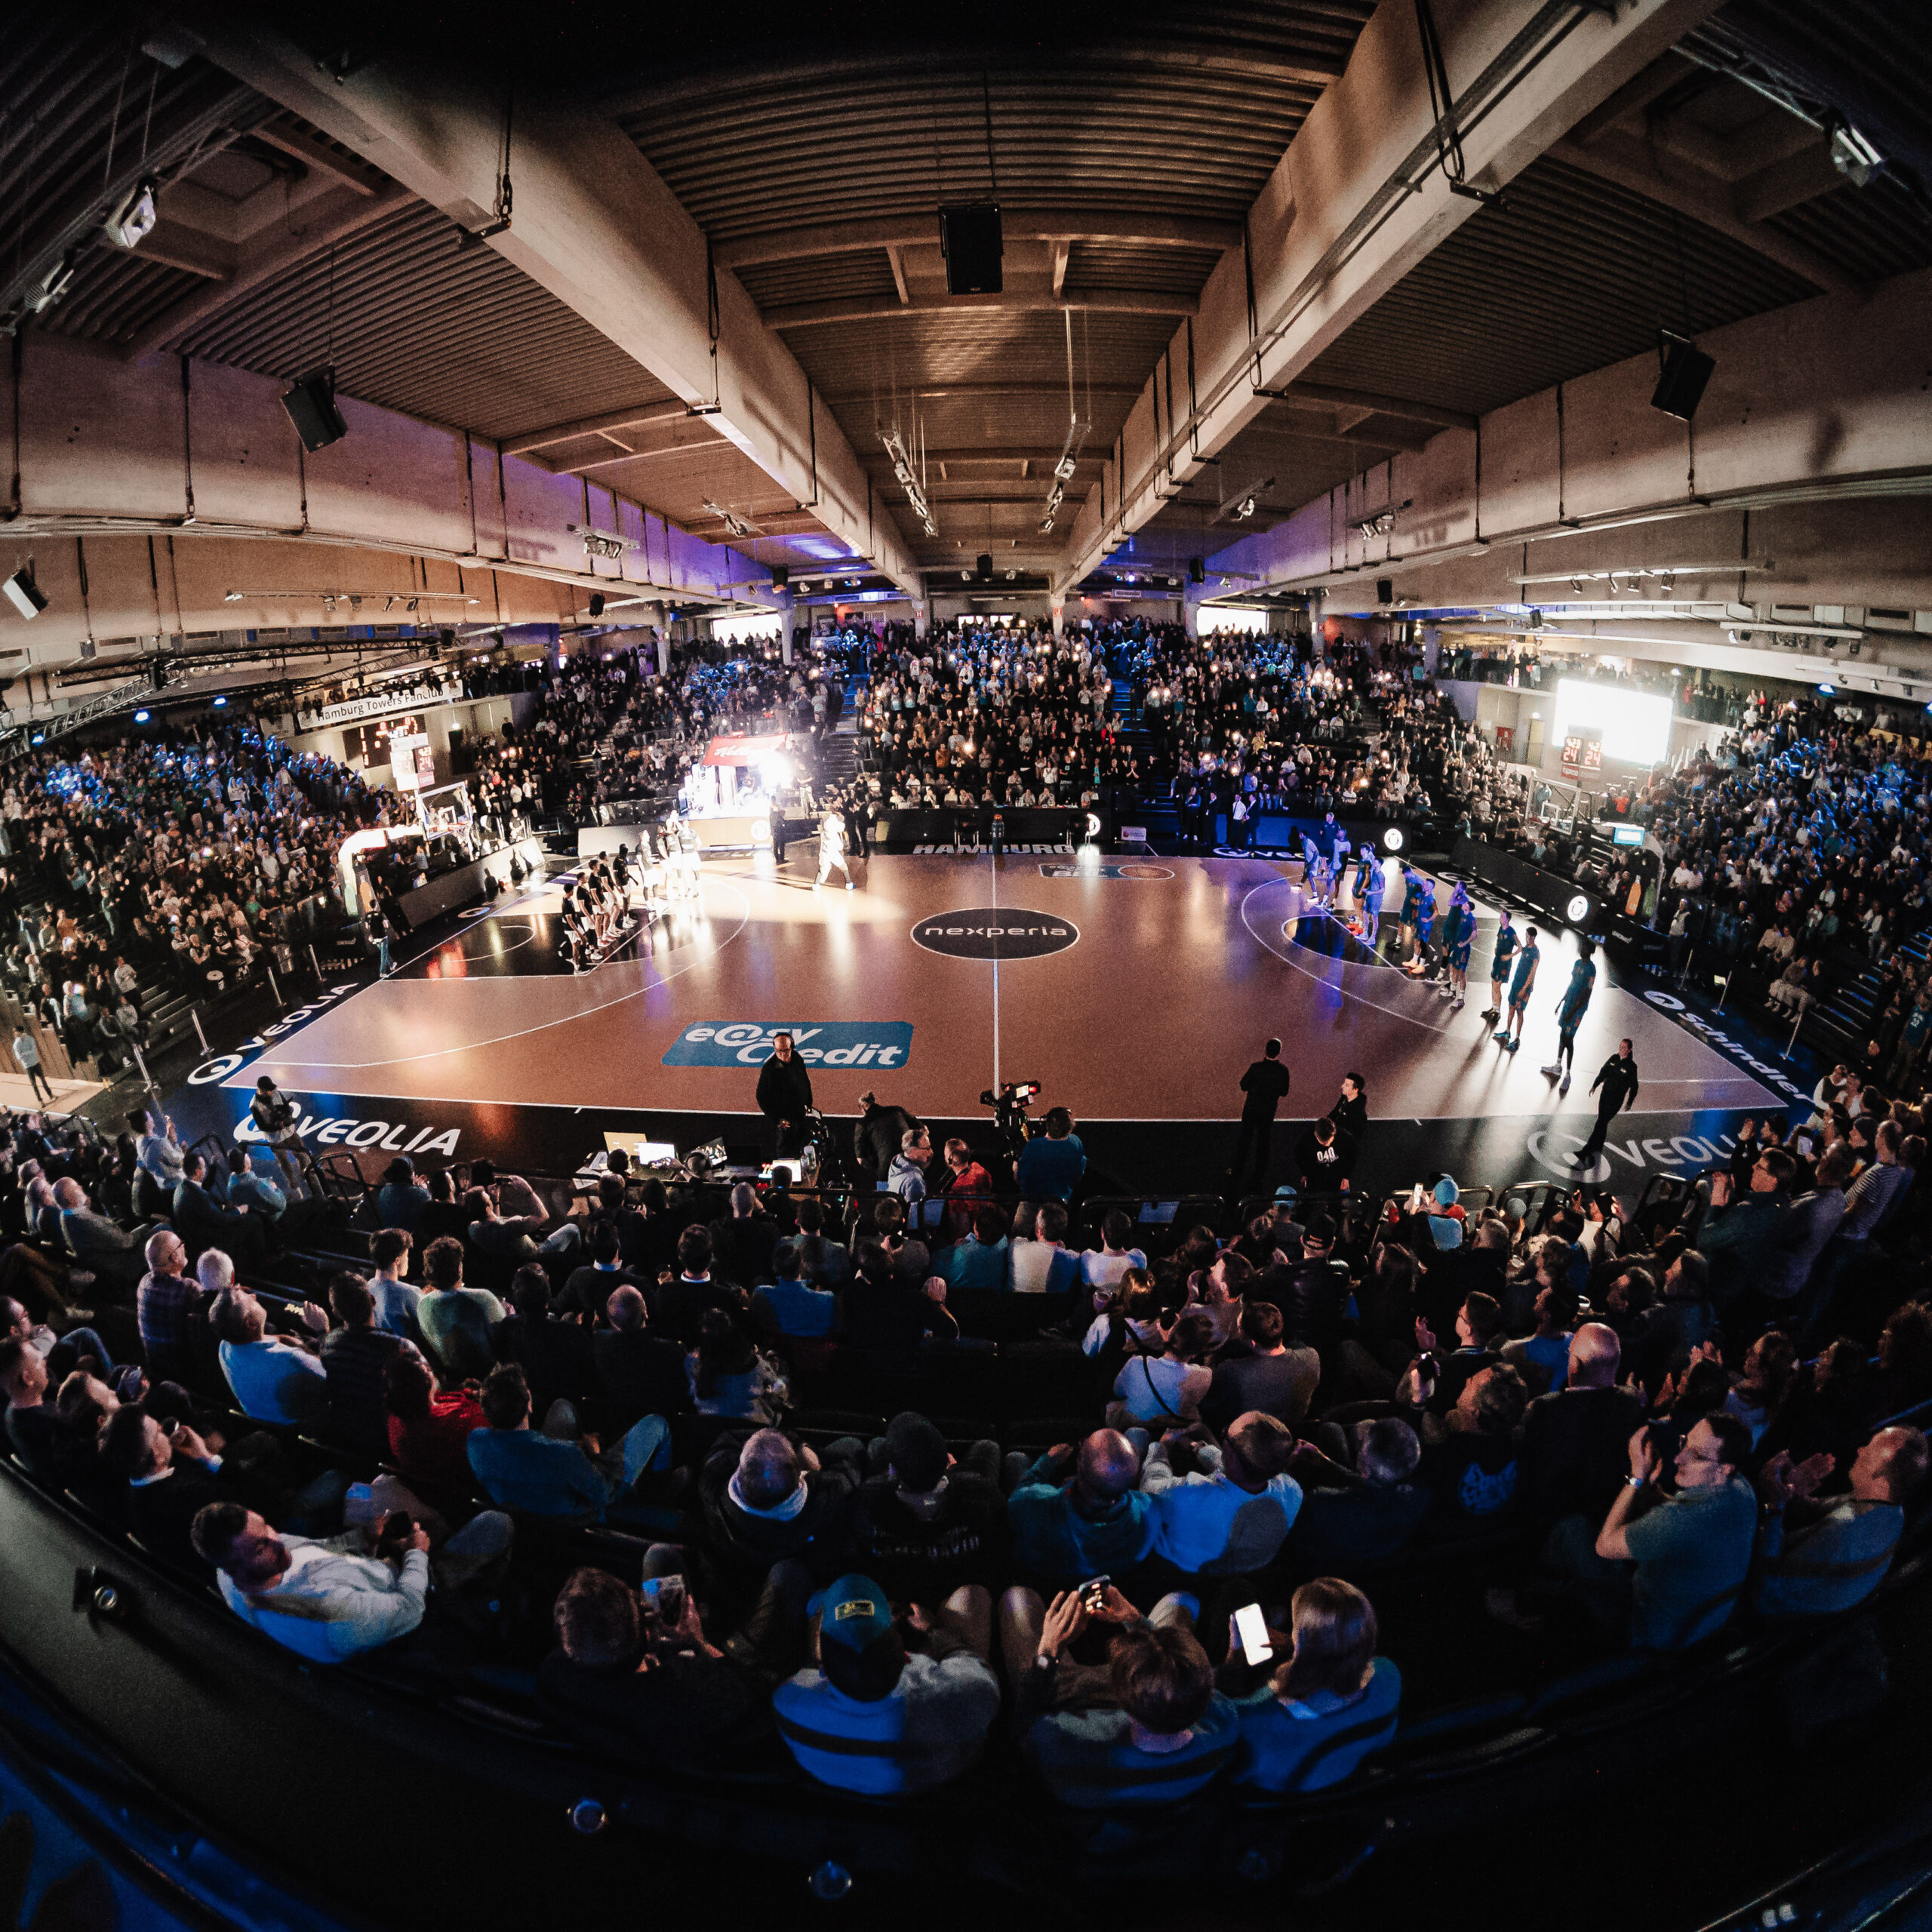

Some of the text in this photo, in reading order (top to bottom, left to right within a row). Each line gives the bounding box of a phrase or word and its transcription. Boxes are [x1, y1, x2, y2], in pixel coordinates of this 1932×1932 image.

[367, 697, 402, 711] Towers
[1562, 746, 1577, 762] 24
[1584, 750, 1601, 766] 24
[924, 926, 1067, 938] nexperia
[235, 983, 359, 1051] VEOLIA
[736, 1042, 903, 1066] Cedit
[300, 1114, 461, 1156] VEOLIA
[1316, 1146, 1336, 1161] 040
